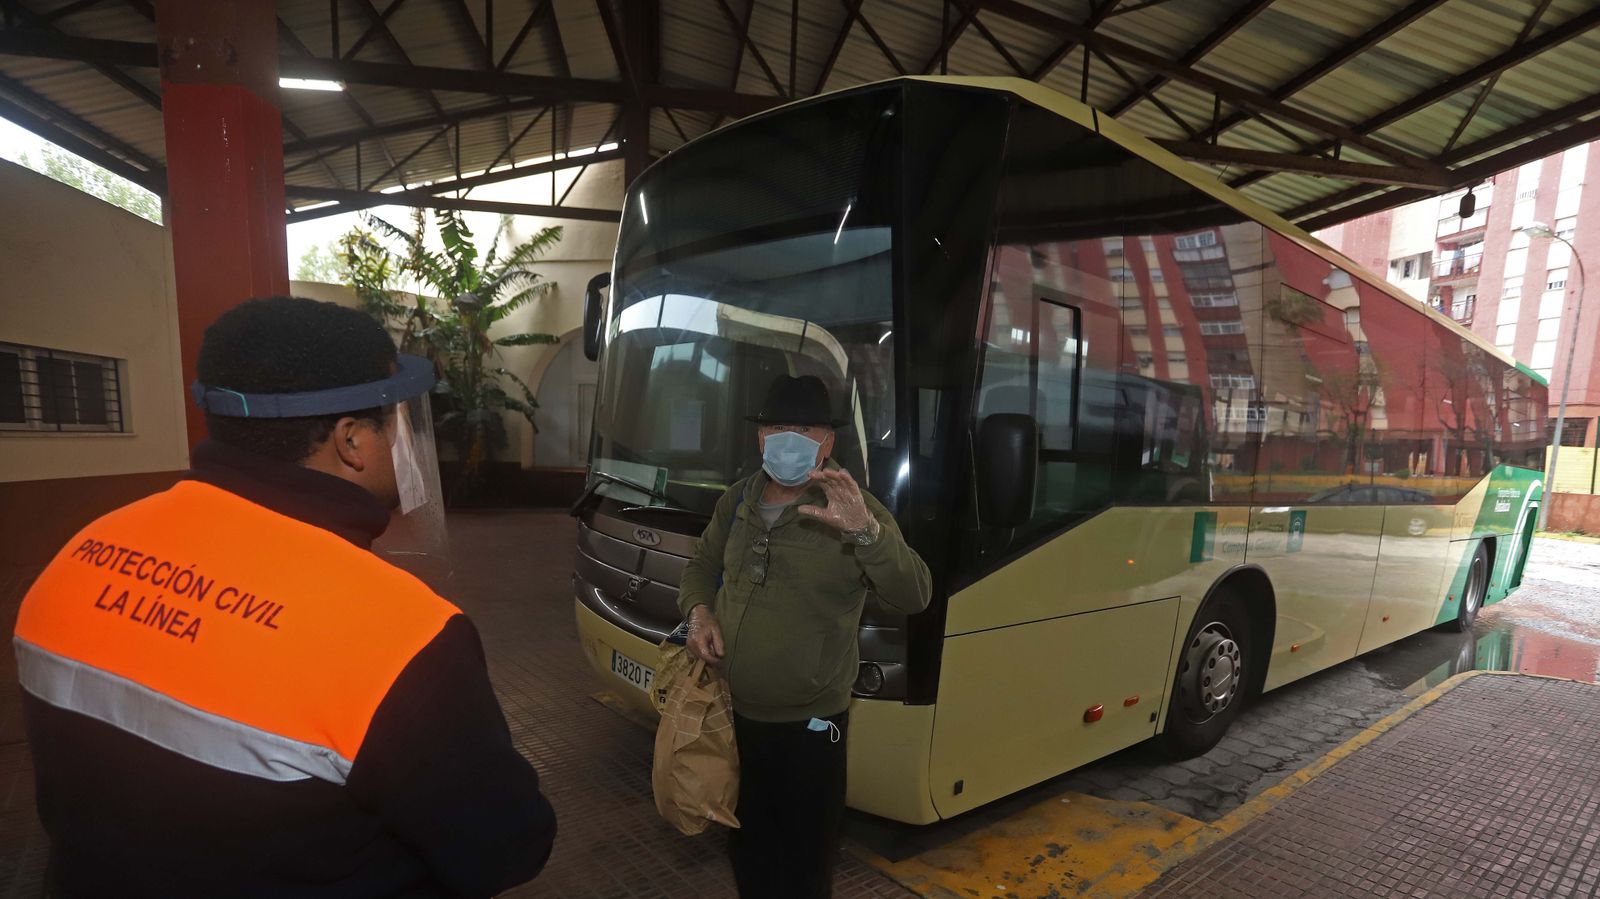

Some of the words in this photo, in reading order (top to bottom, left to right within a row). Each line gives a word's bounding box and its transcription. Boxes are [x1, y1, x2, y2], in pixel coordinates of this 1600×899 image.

[71, 538, 215, 602] PROTECCIÓN
[215, 586, 284, 630] CIVIL
[94, 584, 130, 616] LA
[129, 594, 202, 644] LÍNEA
[617, 656, 641, 684] 3820
[644, 671, 655, 689] F
